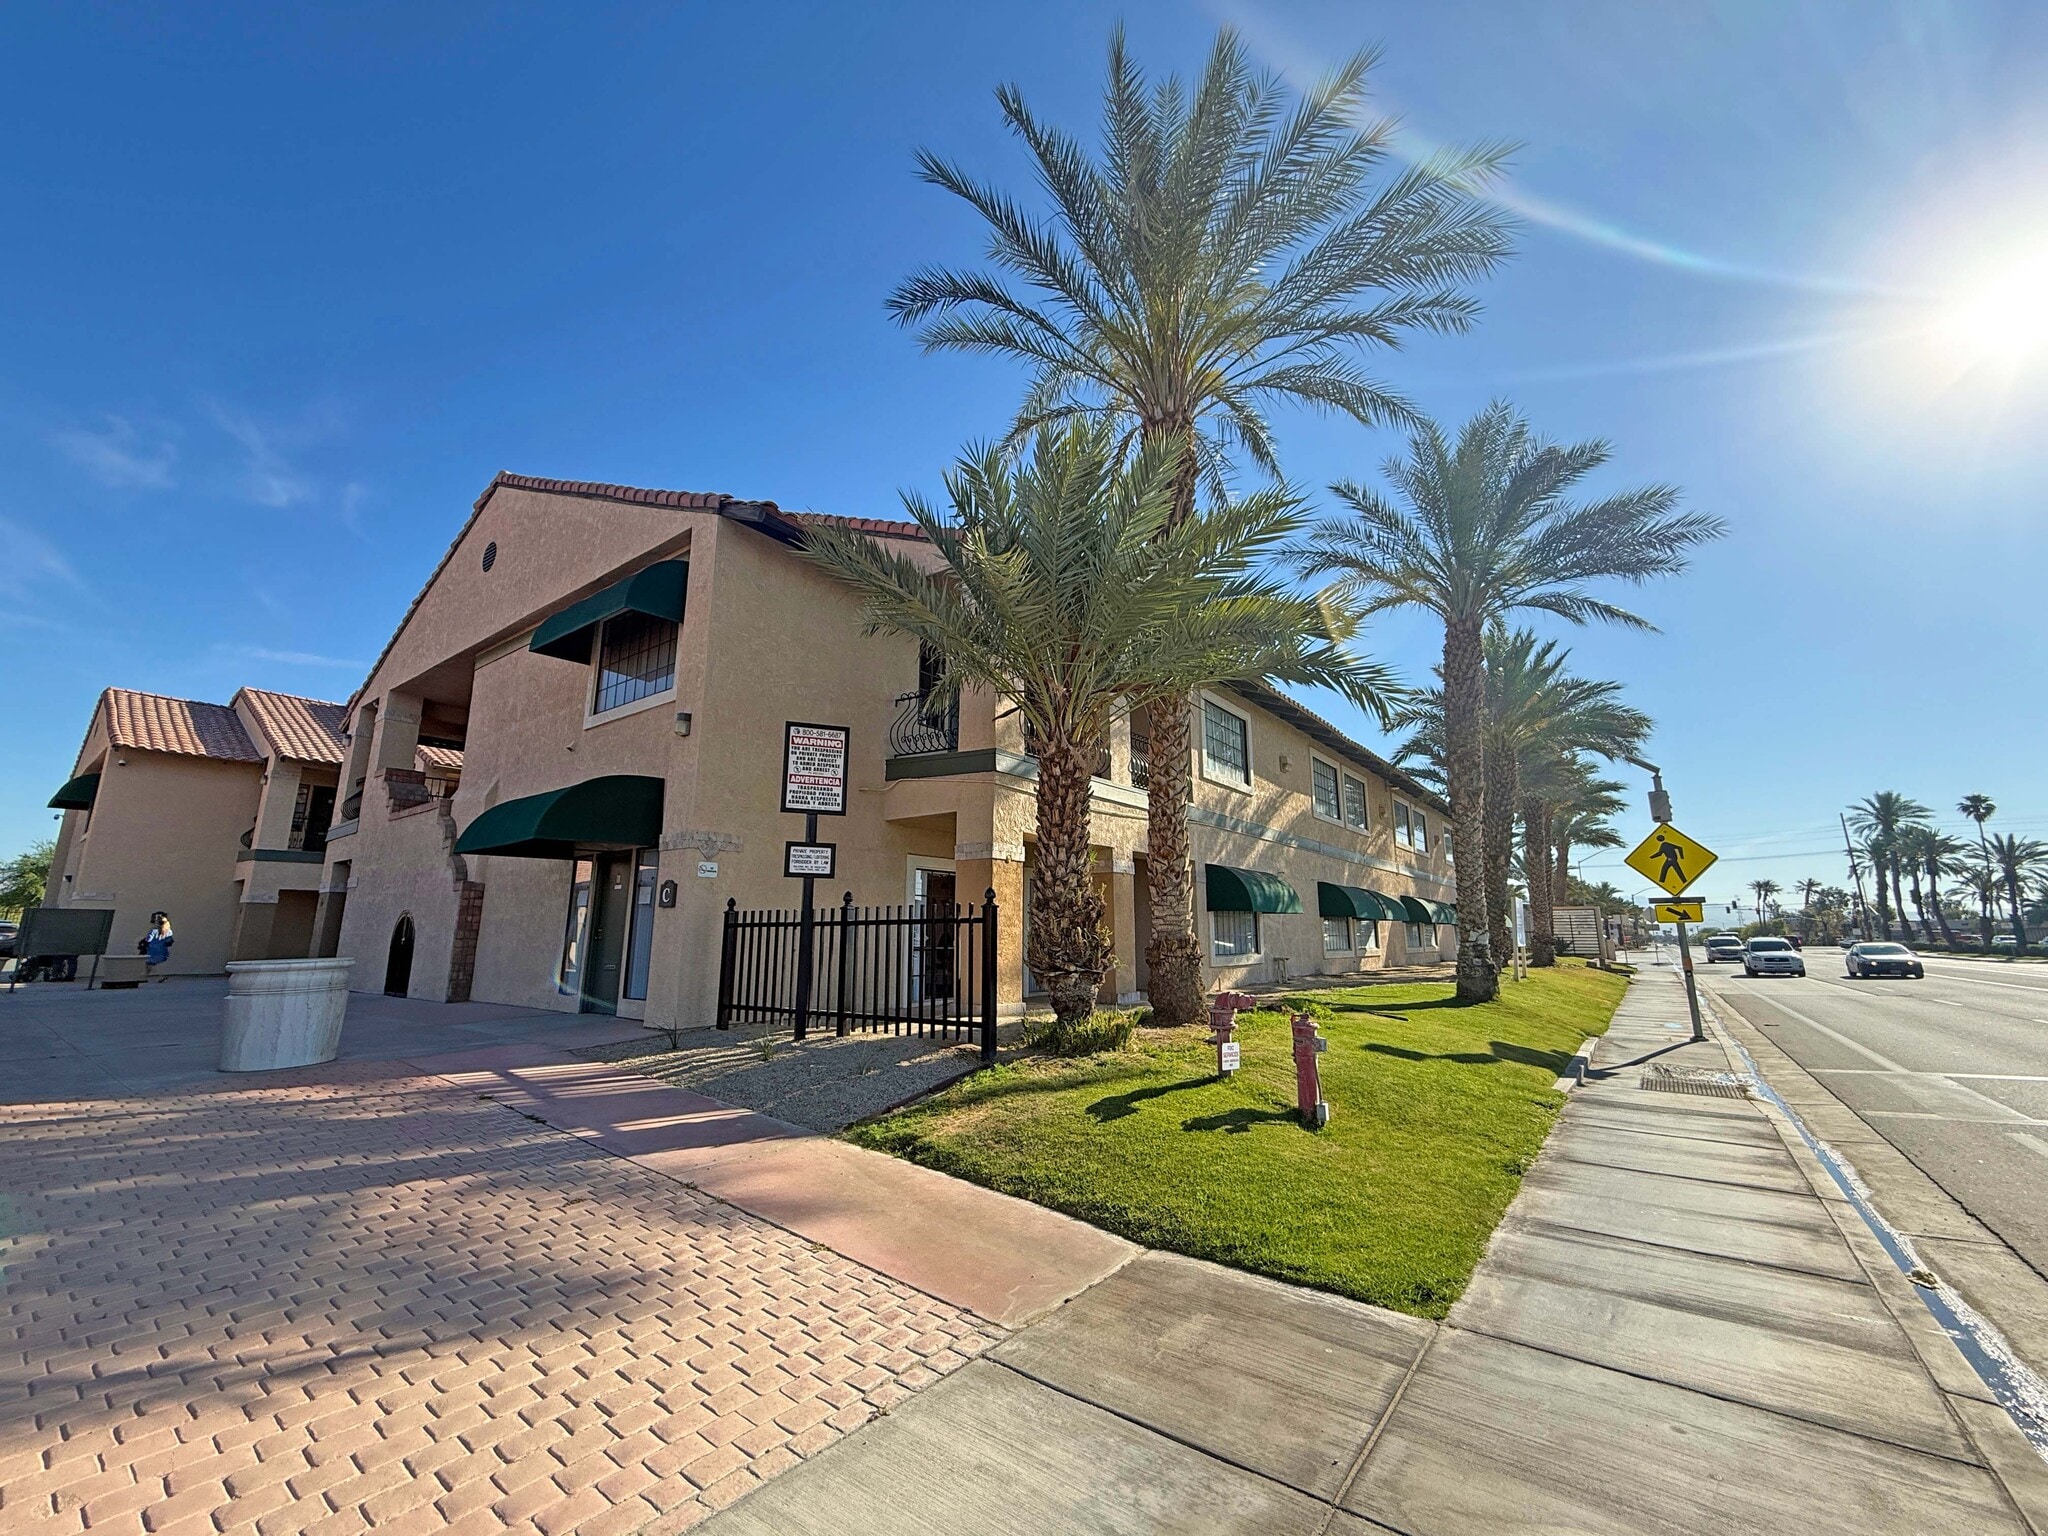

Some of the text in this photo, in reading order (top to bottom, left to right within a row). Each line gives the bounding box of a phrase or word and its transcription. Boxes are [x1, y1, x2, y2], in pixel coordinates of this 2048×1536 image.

[793, 737, 842, 748] WARNING
[790, 776, 840, 786] ADVERTENCIA
[662, 888, 670, 902] C
